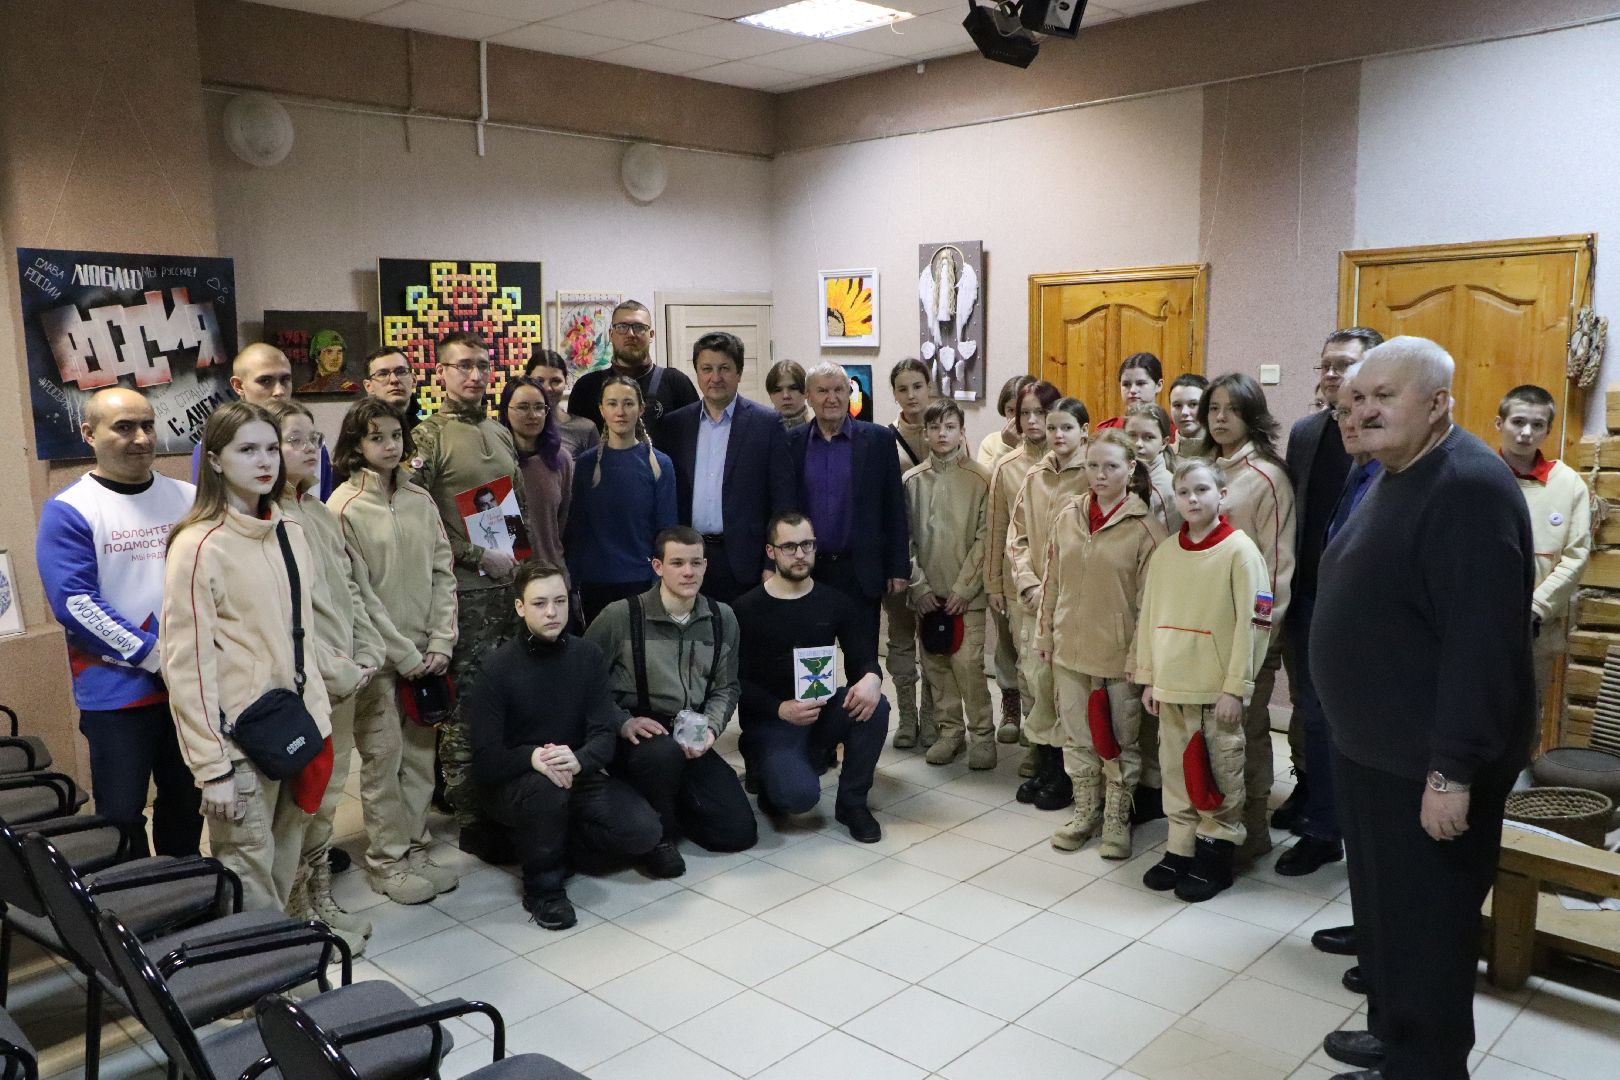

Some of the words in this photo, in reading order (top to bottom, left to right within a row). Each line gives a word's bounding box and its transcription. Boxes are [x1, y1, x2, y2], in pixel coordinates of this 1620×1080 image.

[34, 257, 65, 280] СЛАВА
[71, 263, 144, 291] ЛЮБЛЮ
[23, 266, 62, 300] РОССИИ
[103, 537, 167, 555] ПОДМОСК
[73, 600, 114, 637] РЯДОМ
[111, 633, 136, 652] МЫ
